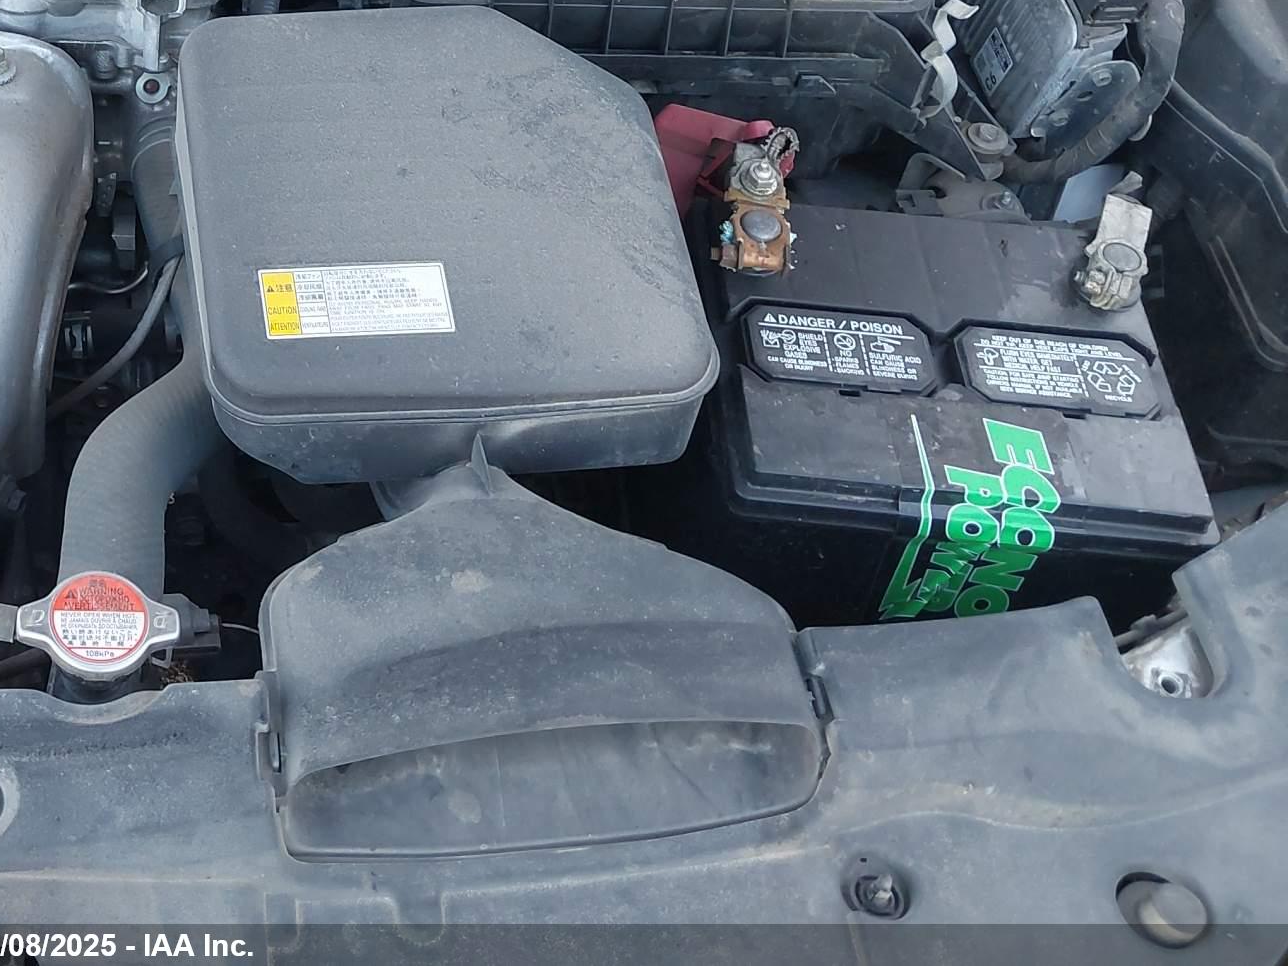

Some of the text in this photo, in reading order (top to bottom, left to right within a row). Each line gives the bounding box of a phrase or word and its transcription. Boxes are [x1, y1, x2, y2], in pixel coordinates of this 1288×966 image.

[268, 306, 298, 315] CAUTION
[270, 322, 300, 331] ATTENTION
[778, 314, 836, 329] DANGER
[850, 320, 903, 335] POISON
[798, 332, 824, 341] SHIELD
[783, 344, 821, 354] EXPLOSIVE
[904, 356, 922, 364] ACID
[954, 418, 1061, 619] ECONO
[79, 586, 124, 596] WARNING
